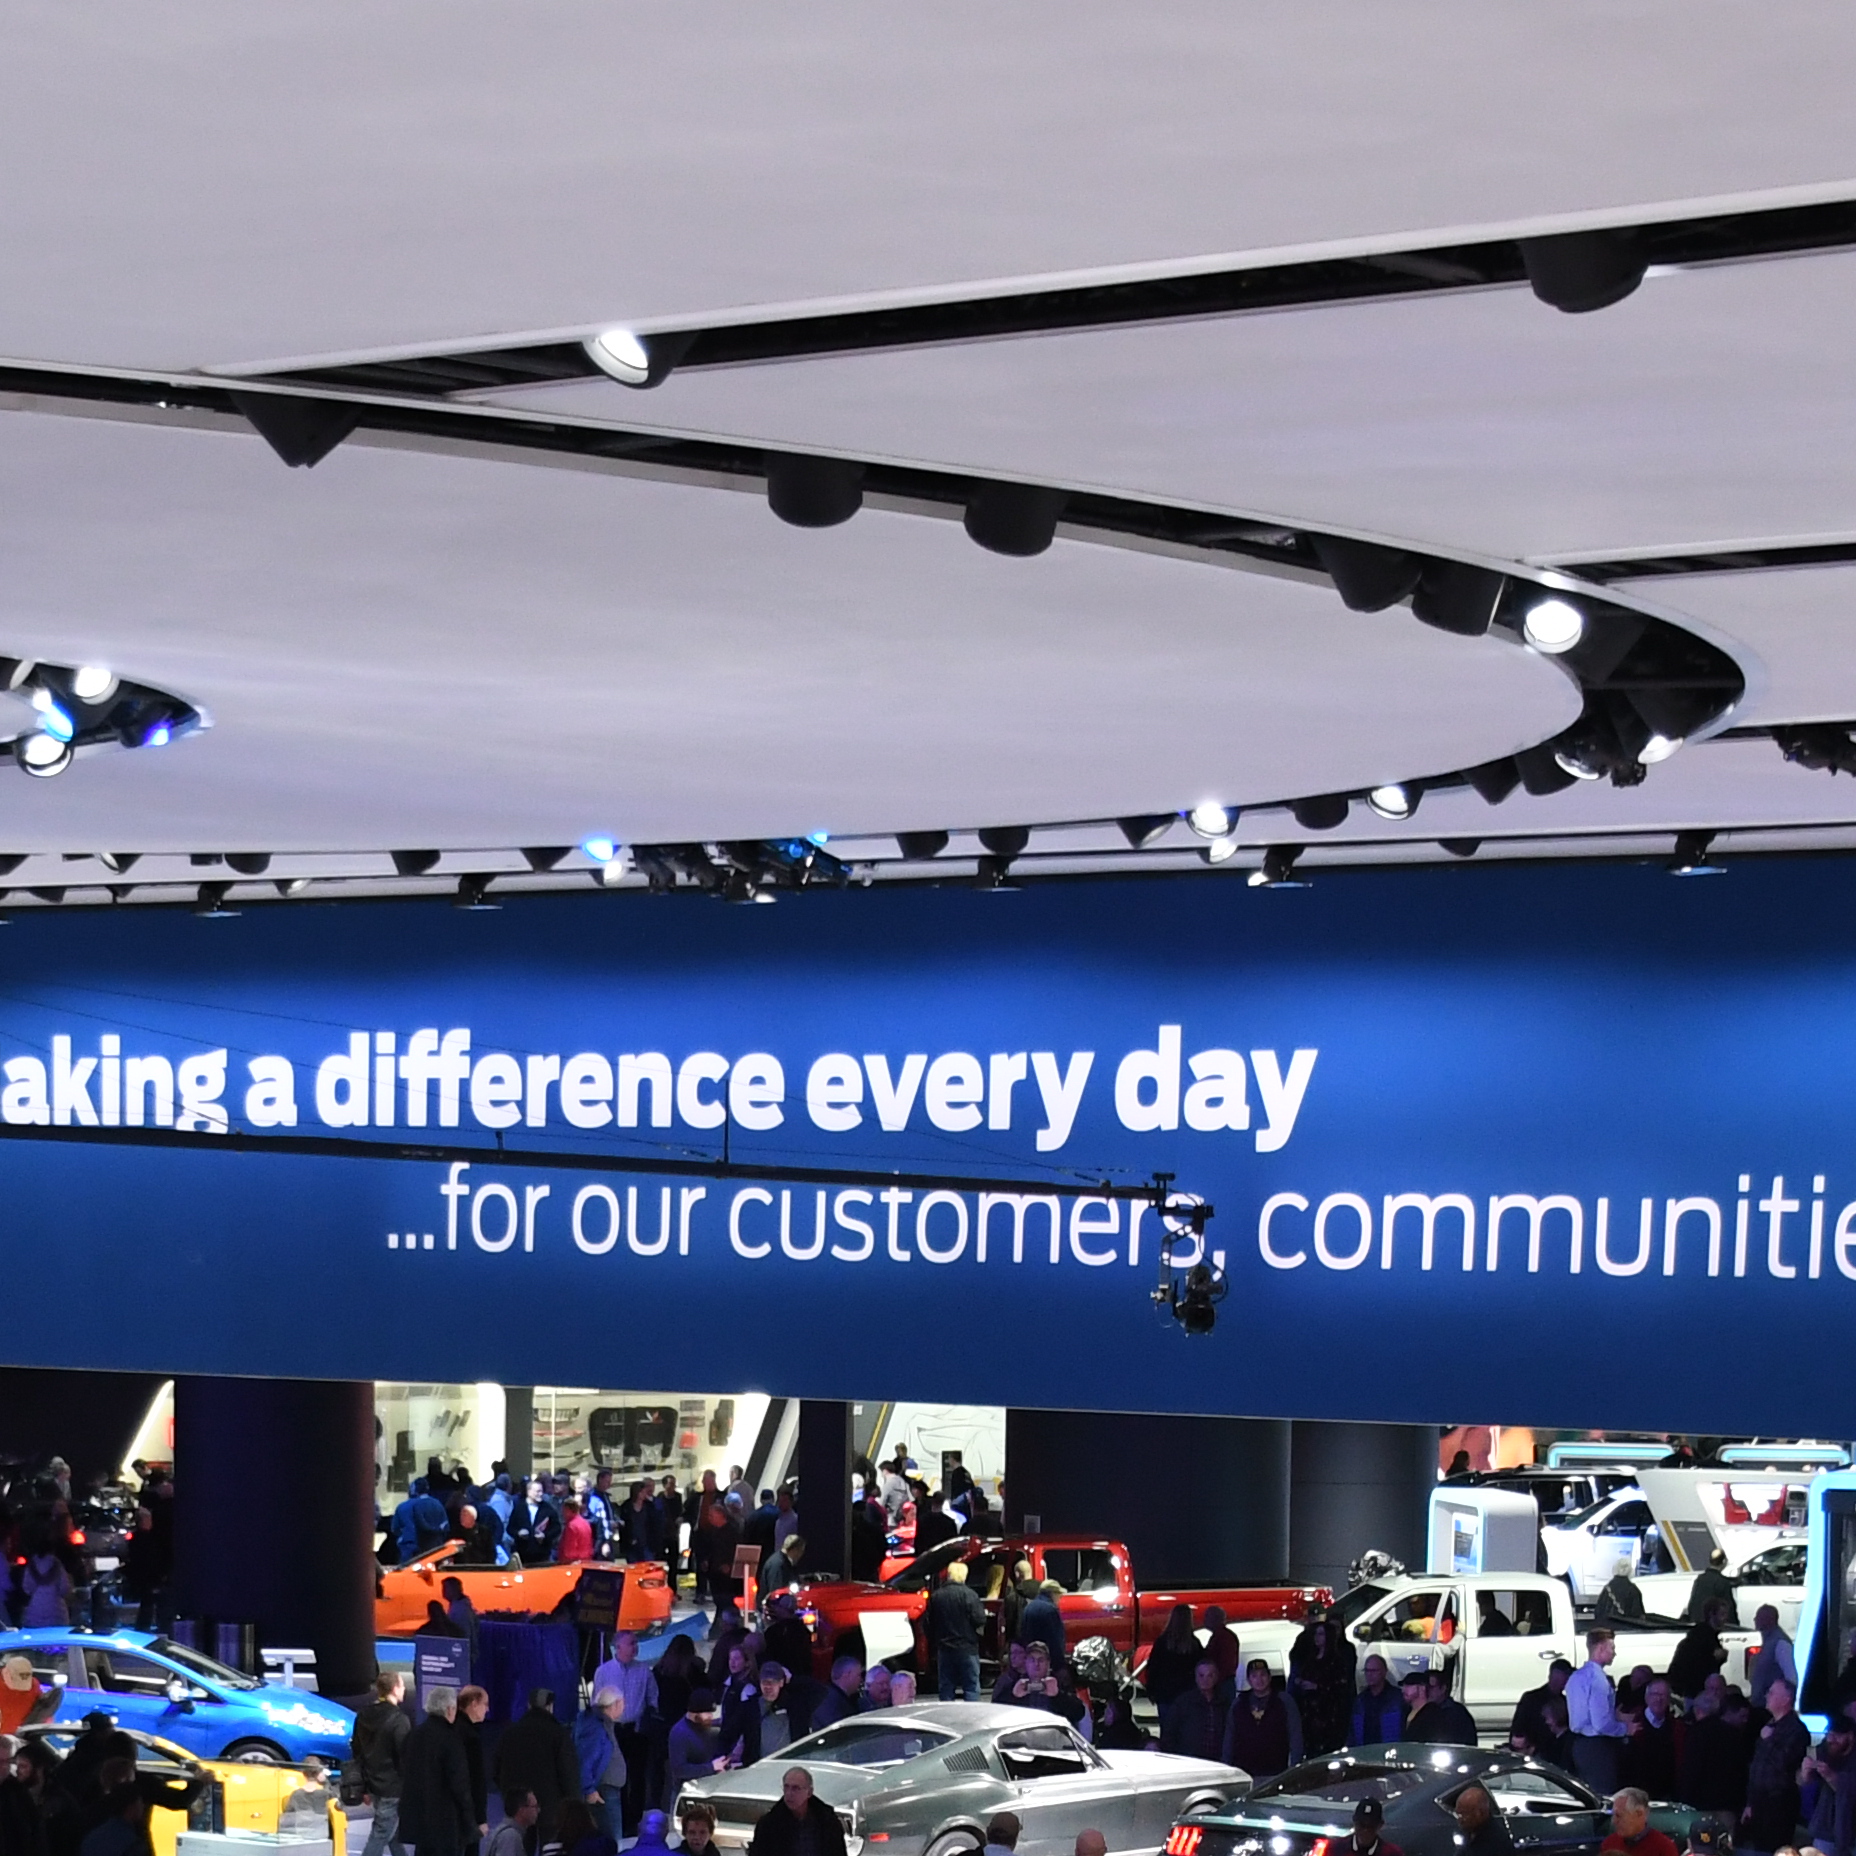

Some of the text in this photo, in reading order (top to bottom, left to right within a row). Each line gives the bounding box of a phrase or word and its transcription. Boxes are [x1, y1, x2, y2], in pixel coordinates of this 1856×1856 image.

[246, 1053, 298, 1128] a
[315, 1028, 785, 1131] difference
[805, 1050, 1095, 1152] every
[1114, 1025, 1320, 1152] day
[571, 1184, 706, 1257] our
